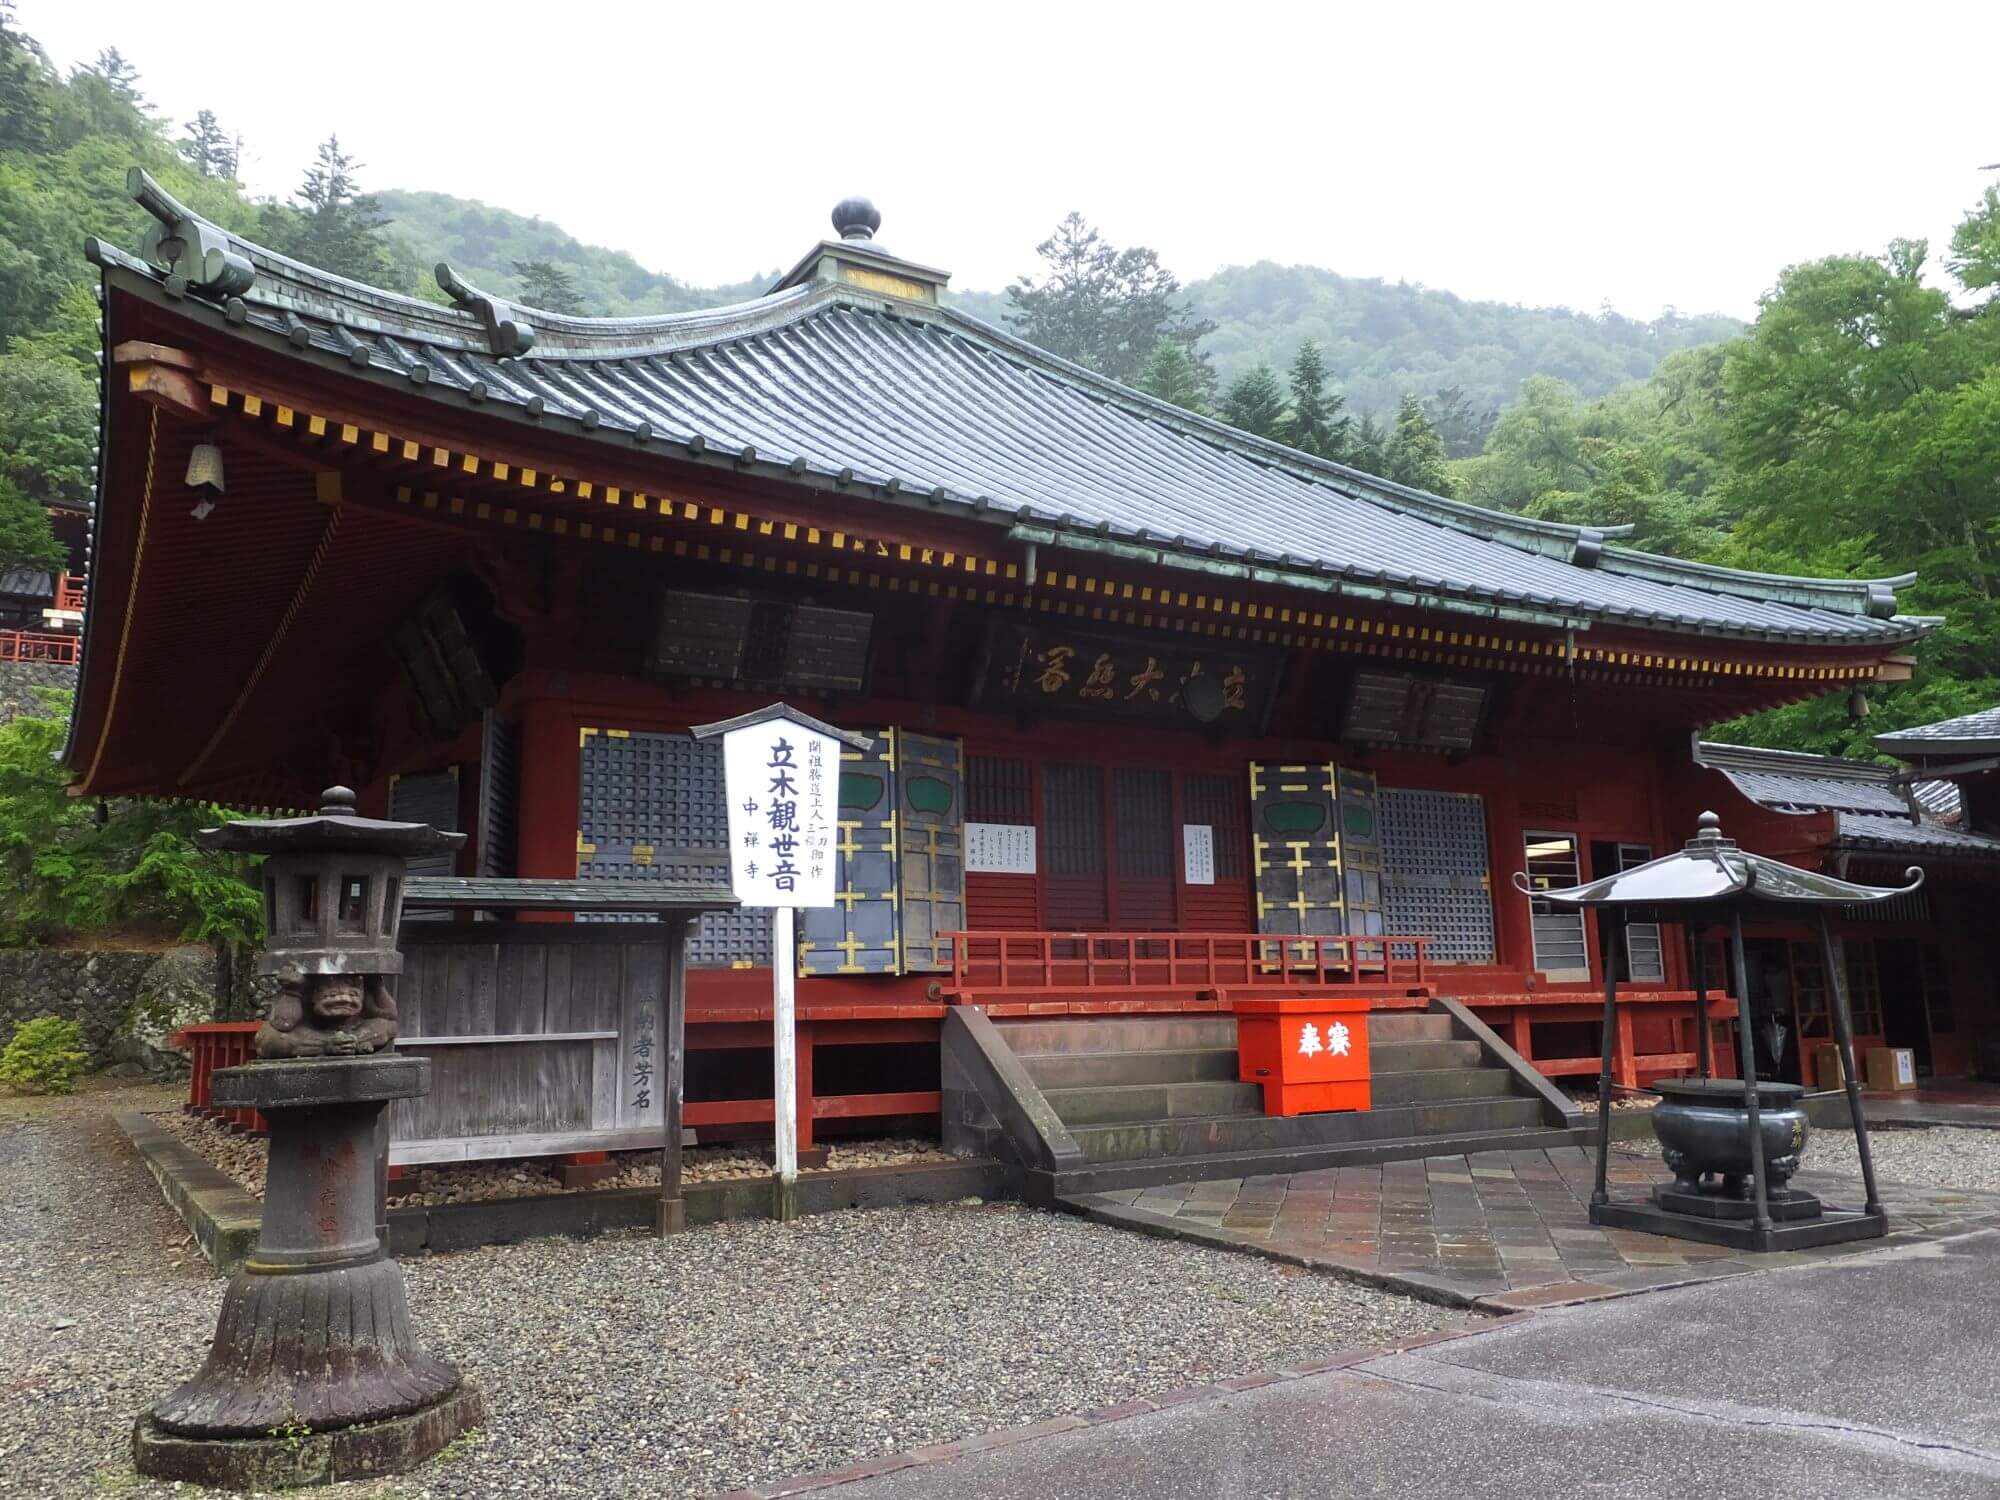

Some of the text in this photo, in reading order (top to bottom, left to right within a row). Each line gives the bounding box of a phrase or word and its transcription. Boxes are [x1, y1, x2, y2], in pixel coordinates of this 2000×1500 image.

[742, 796, 760, 880] 中禅寺
[766, 736, 801, 893] 立木観世音
[1297, 1021, 1352, 1059] 奉賽
